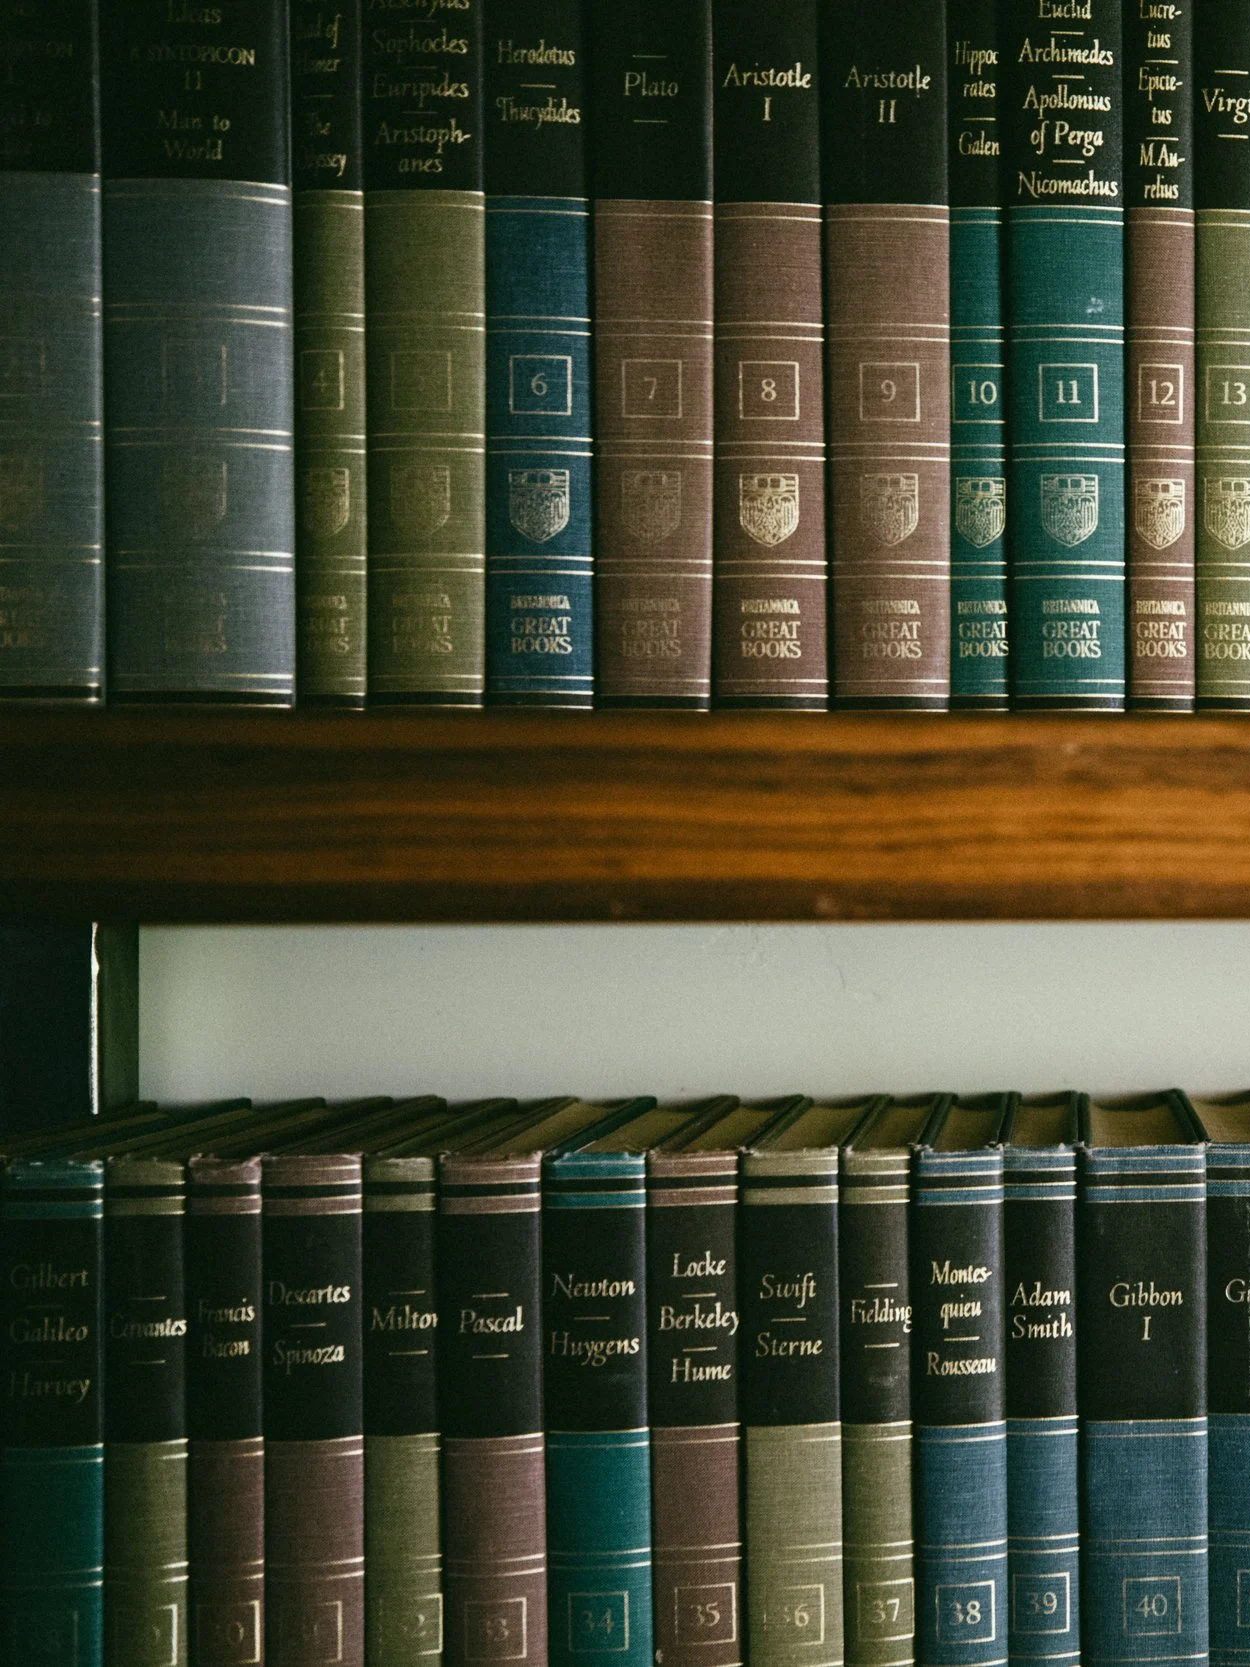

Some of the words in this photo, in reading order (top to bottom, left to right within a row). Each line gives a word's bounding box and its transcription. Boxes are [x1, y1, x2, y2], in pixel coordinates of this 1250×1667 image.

[1037, 0, 1092, 20] Euclid
[1139, 0, 1182, 20] Lucre-
[371, 32, 468, 65] Sophocles
[1147, 25, 1171, 49] tius
[498, 40, 575, 65] Herodotus
[1018, 38, 1114, 66] Archimedes
[623, 72, 678, 98] Plato
[723, 62, 812, 88] Aristotle
[844, 65, 930, 91] Aristotle
[1139, 66, 1182, 101] Epicte-
[372, 70, 469, 108] Euripides
[963, 79, 996, 98] rates
[496, 97, 580, 129] Thucydides
[763, 97, 772, 120] I
[878, 100, 896, 123] II
[1022, 86, 1111, 118] Apollonius
[1152, 106, 1172, 125] tus
[374, 119, 471, 155] Aristoph-
[958, 132, 1000, 156] Galen
[1030, 122, 1046, 155] of
[1054, 121, 1103, 158] Perga
[398, 155, 444, 173] anes
[1017, 171, 1118, 197] Nicomachus
[1144, 171, 1179, 199] relius
[532, 373, 548, 396] 6
[761, 378, 777, 400] 8
[881, 380, 896, 402] 9
[968, 381, 997, 404] 10
[1055, 381, 1081, 404] 11
[1149, 382, 1176, 405] 12
[1221, 382, 1247, 405] 13
[1136, 600, 1186, 615] BRITANNICA
[741, 622, 800, 638] GREAT
[1136, 621, 1186, 638] GREAT
[741, 640, 800, 658] BOOKS
[1136, 640, 1186, 658] BOOKS
[672, 1251, 726, 1278] Locke
[931, 1260, 992, 1284] Montes-
[269, 1281, 351, 1305] Descartes
[552, 1273, 635, 1298] Newton
[760, 1272, 816, 1309] Swift
[1012, 1281, 1071, 1306] Adam
[1109, 1282, 1182, 1307] Gibbon
[460, 1306, 524, 1333] Pascal
[659, 1300, 740, 1335] Berkeley
[851, 1300, 912, 1332] Fielding
[940, 1296, 982, 1329] quieu
[1012, 1313, 1072, 1338] Smith
[1142, 1316, 1151, 1340] I
[204, 1335, 250, 1357] Bacon
[550, 1331, 640, 1366] Huygens
[756, 1332, 822, 1357] Sterne
[274, 1340, 345, 1375] Spinoza
[927, 1352, 996, 1375] Rousseau
[671, 1358, 732, 1384] Hume
[872, 1600, 899, 1624] 37
[950, 1600, 982, 1626] 38
[1027, 1592, 1057, 1614] 39
[1135, 1594, 1167, 1618] 40
